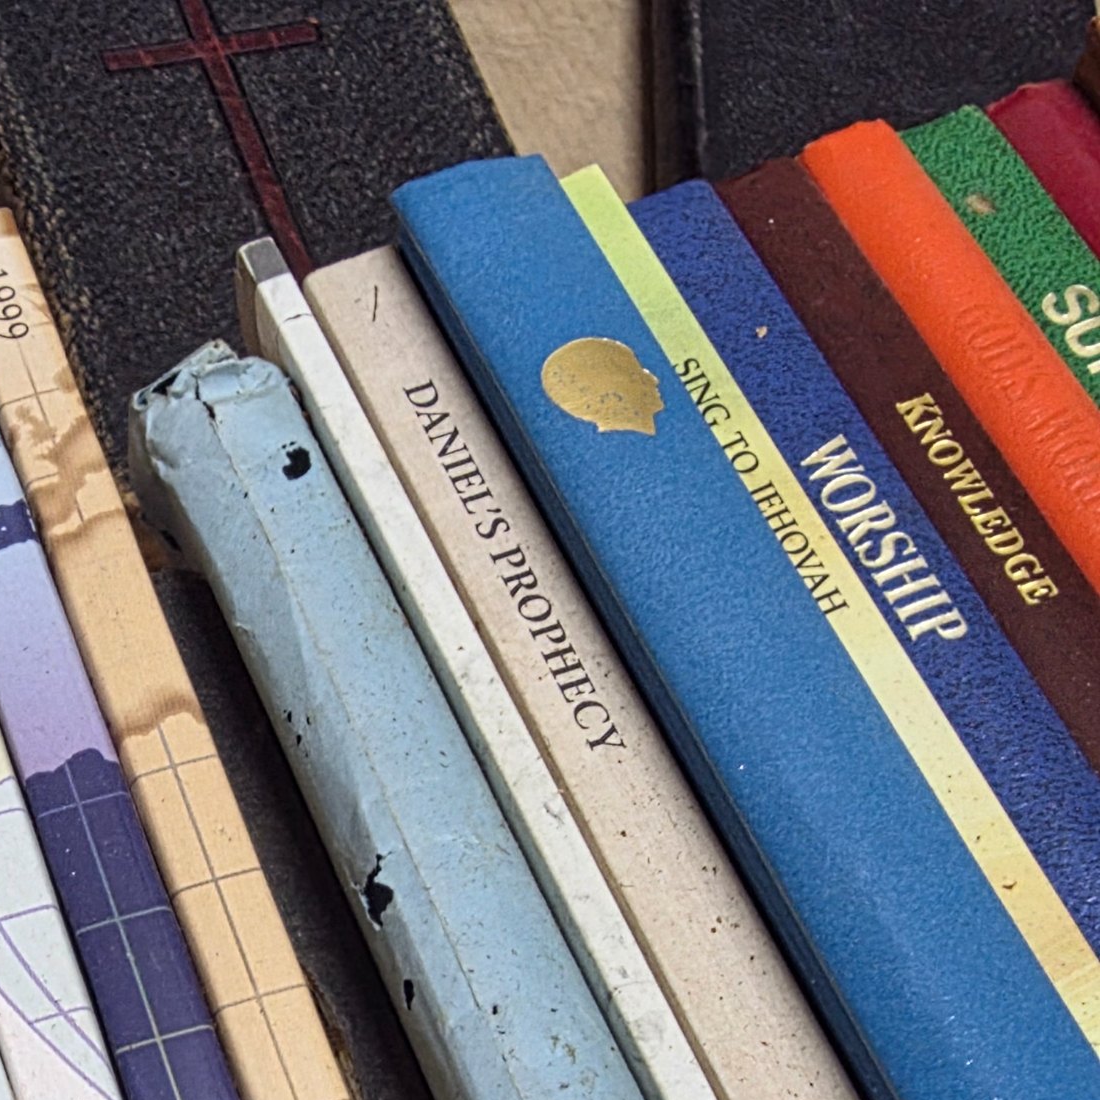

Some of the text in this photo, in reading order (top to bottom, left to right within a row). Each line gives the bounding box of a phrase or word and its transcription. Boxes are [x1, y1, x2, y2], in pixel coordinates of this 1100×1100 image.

[672, 357, 732, 428] SING
[722, 431, 760, 475] TO
[1042, 284, 1100, 374] SU
[402, 378, 628, 752] DANIEL'S PROPHECY
[799, 432, 970, 643] WORSHIP
[895, 391, 1060, 606] KNOWLEDGE
